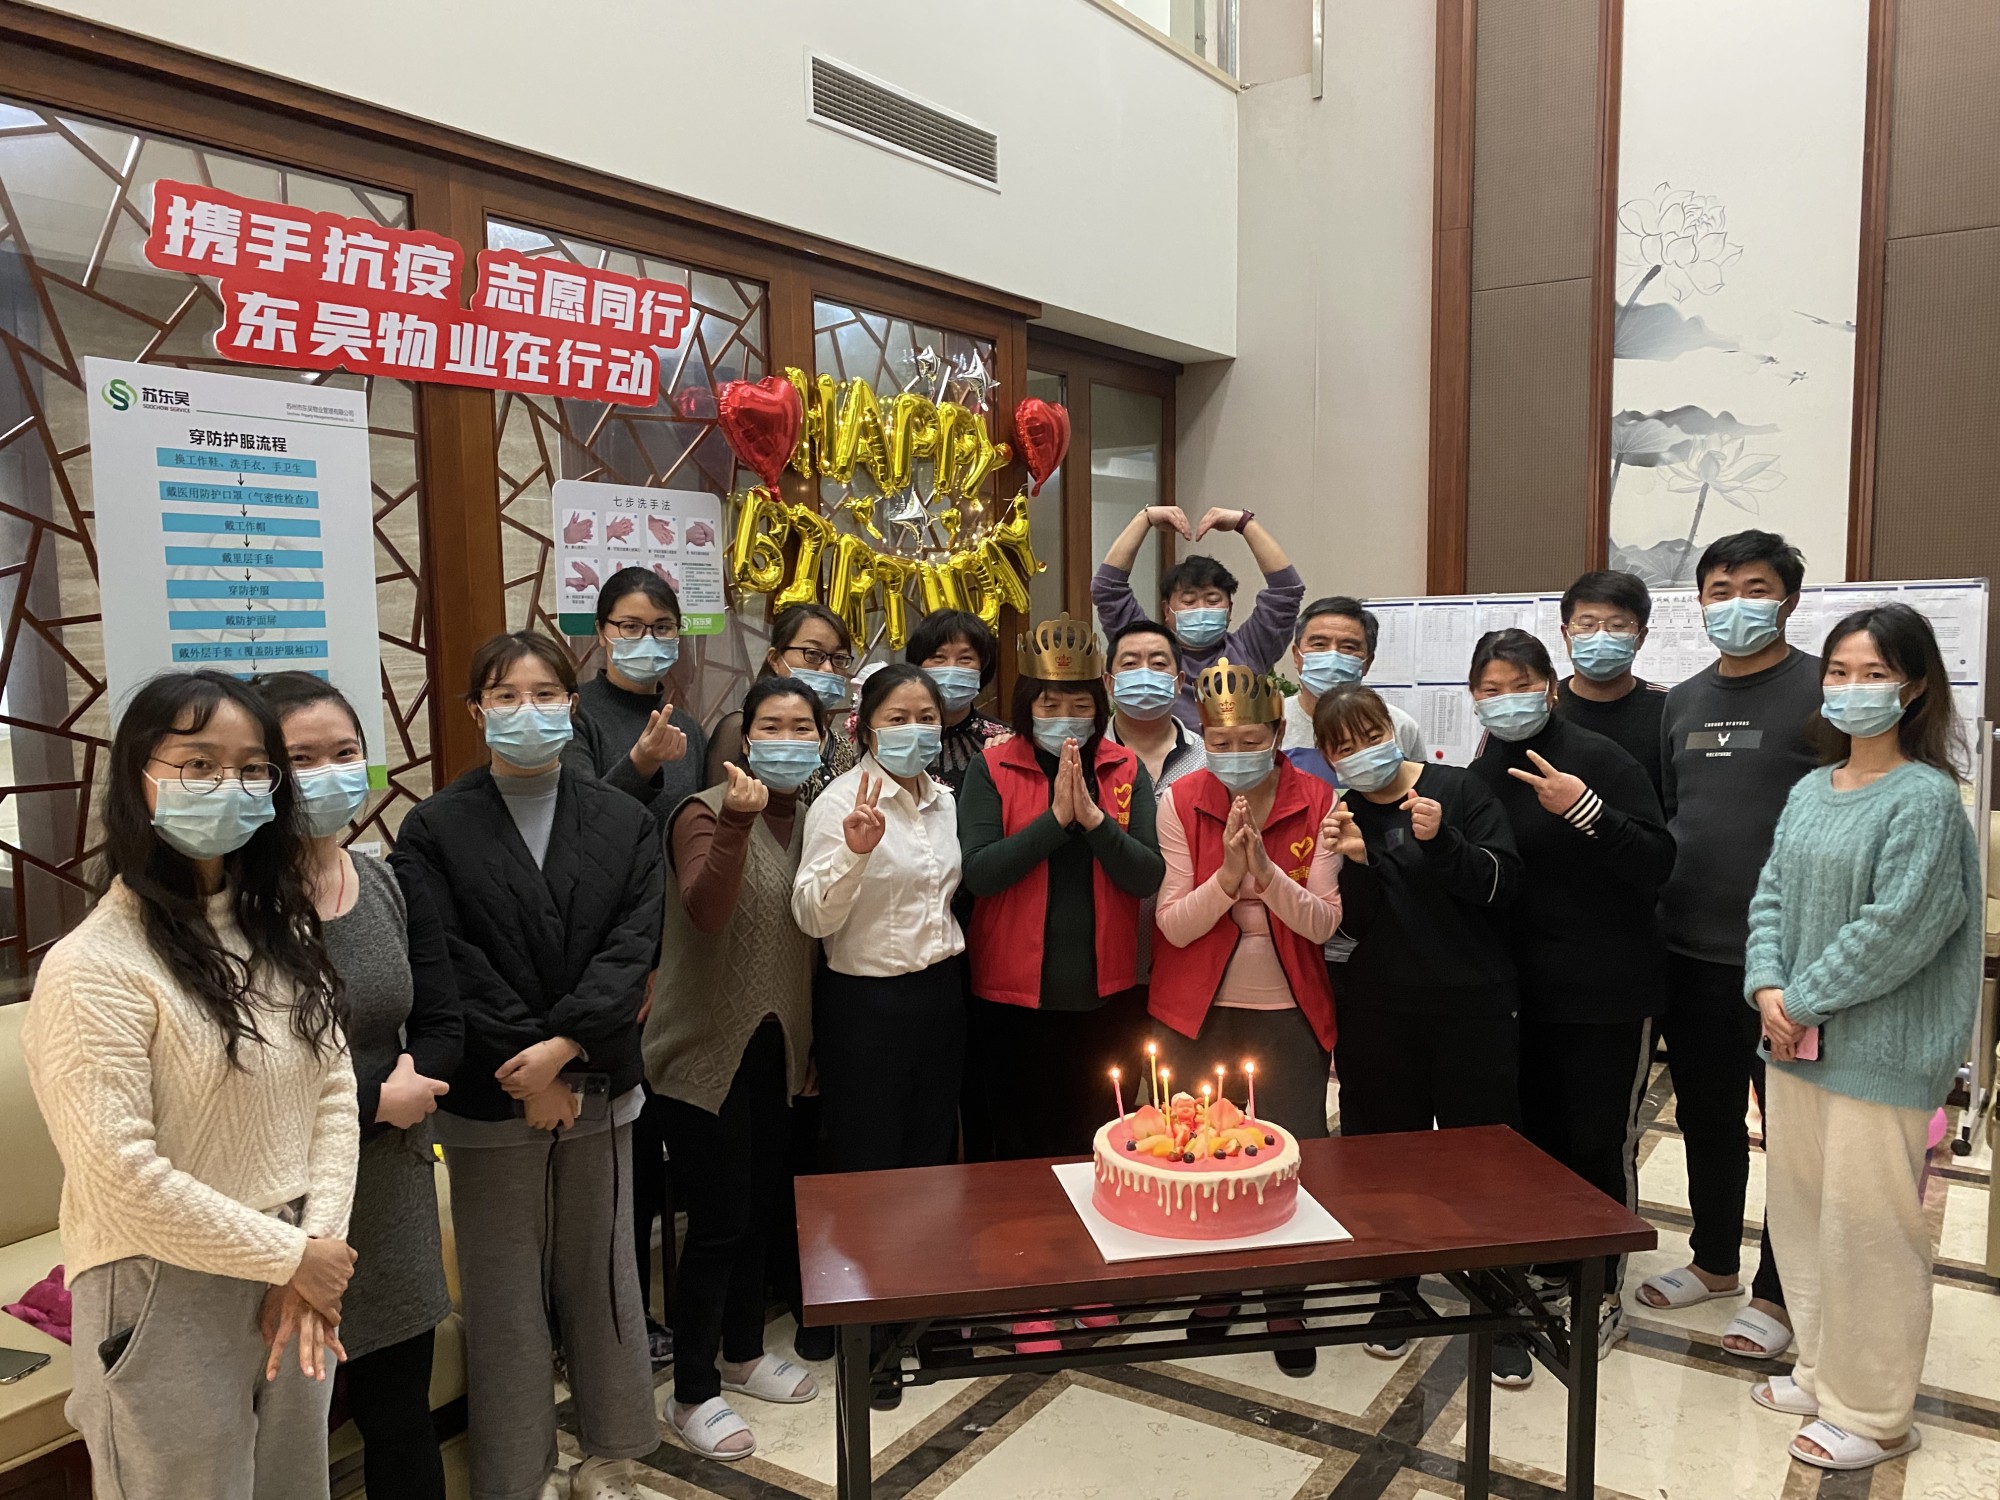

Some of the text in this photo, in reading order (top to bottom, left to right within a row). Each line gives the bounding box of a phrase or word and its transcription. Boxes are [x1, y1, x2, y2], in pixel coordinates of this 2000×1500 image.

[165, 195, 685, 339] 携手抗疫 志愿同行
[231, 291, 655, 397] 东吴物业在行动
[141, 386, 190, 407] 苏东吴
[190, 428, 288, 453] 穿防护服流程
[786, 367, 1011, 502] HAPPY
[613, 496, 671, 511] 七步洗手法
[224, 520, 266, 533] 戴工作帽
[221, 552, 274, 565] 戴里层手套
[228, 584, 270, 597] 穿防护服
[225, 614, 277, 627] 戴防护面屏
